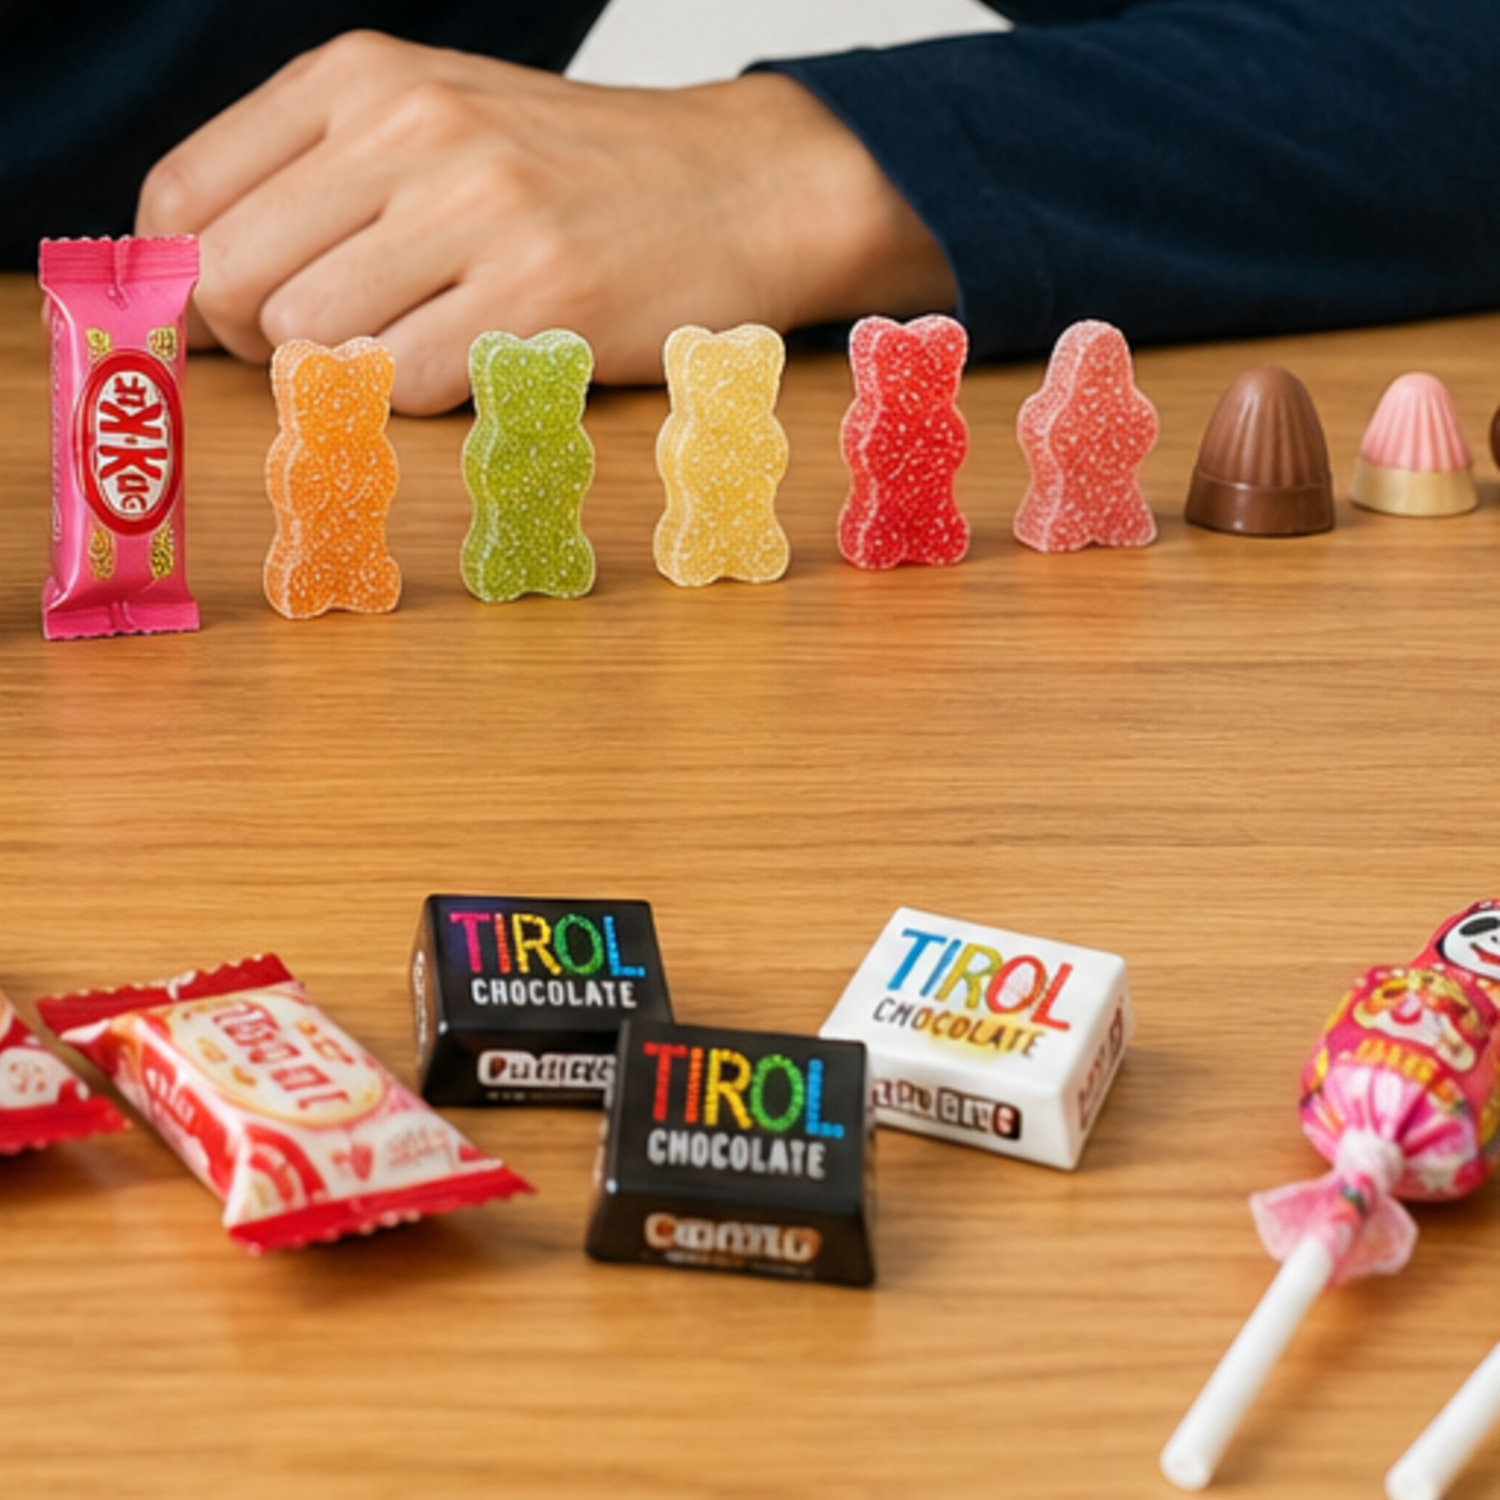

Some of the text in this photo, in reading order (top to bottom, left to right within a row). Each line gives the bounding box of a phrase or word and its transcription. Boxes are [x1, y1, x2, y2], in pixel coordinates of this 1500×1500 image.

[449, 911, 647, 978] TIROL
[470, 978, 638, 1009] CHOCOLATE
[886, 927, 1074, 1032] TIROL
[871, 996, 1045, 1058] CHOCOLATE
[643, 1041, 845, 1139] TIROL
[646, 1128, 827, 1180] CHOCOLATE
